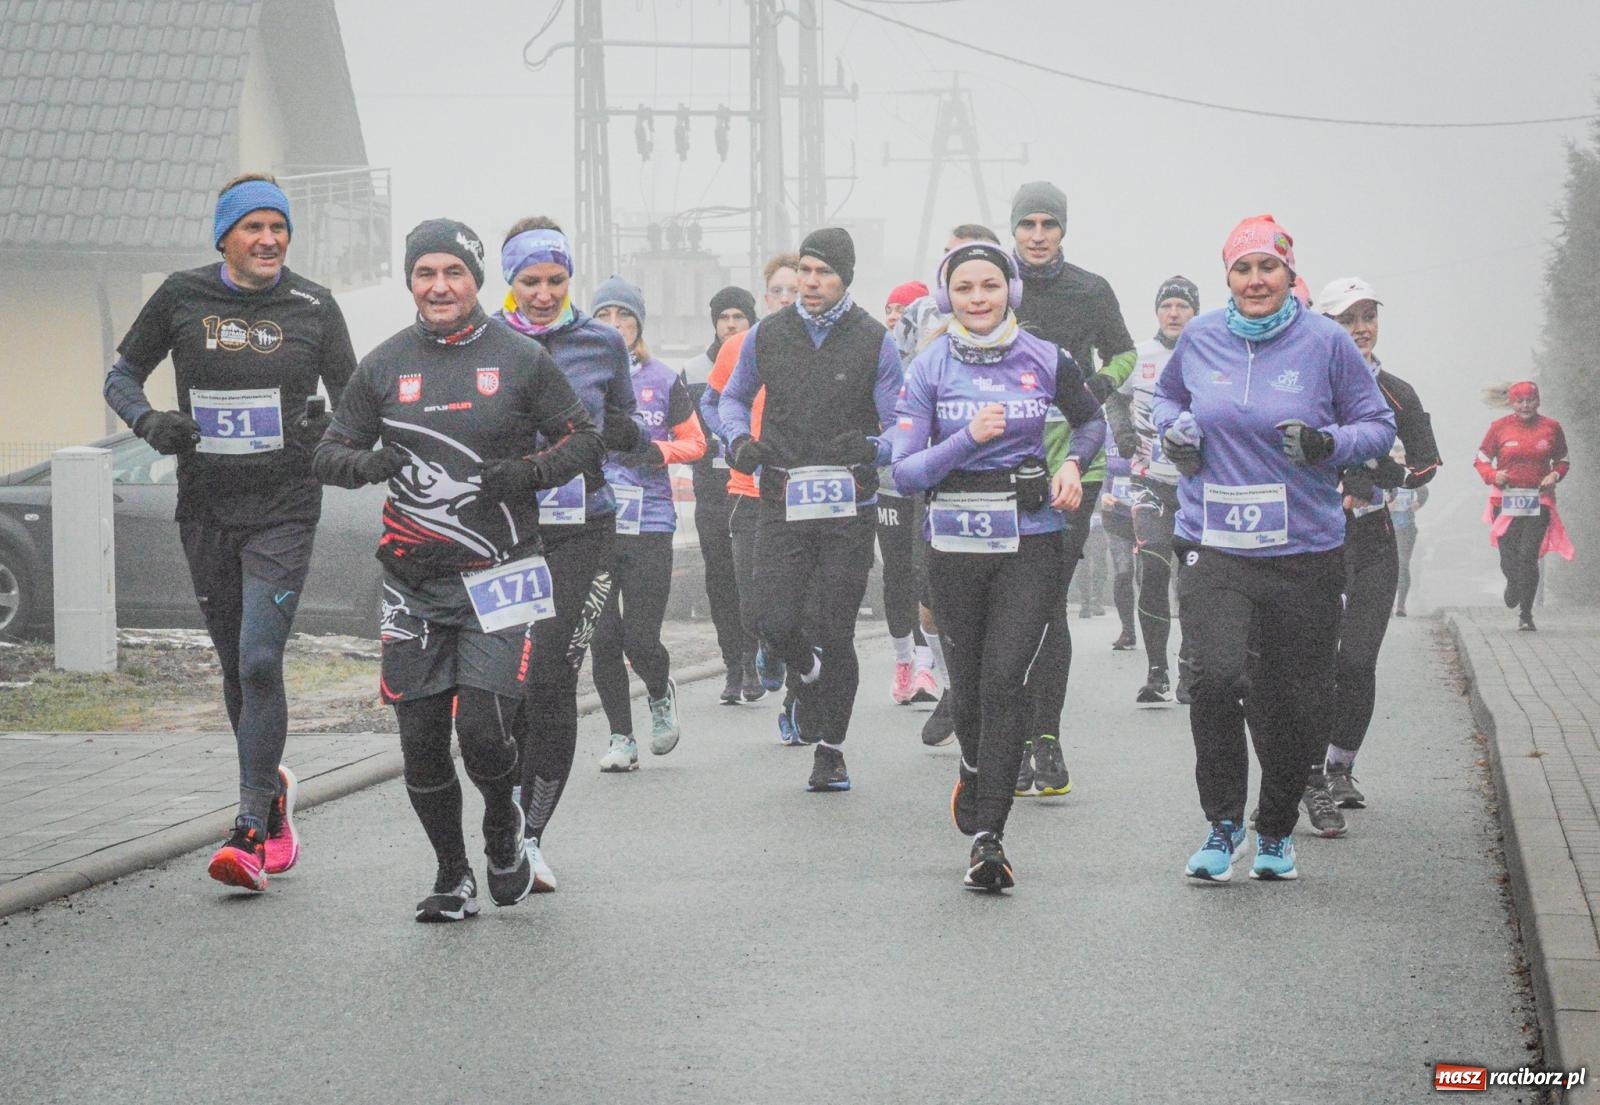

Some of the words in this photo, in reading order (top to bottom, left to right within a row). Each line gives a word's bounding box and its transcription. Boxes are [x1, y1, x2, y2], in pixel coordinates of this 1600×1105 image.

[936, 399, 1049, 420] RUNERS
[217, 410, 256, 436] 51
[797, 480, 843, 504] 153
[1510, 496, 1535, 508] 107
[956, 511, 993, 537] 13
[1225, 504, 1262, 531] 49
[488, 569, 543, 608] 171
